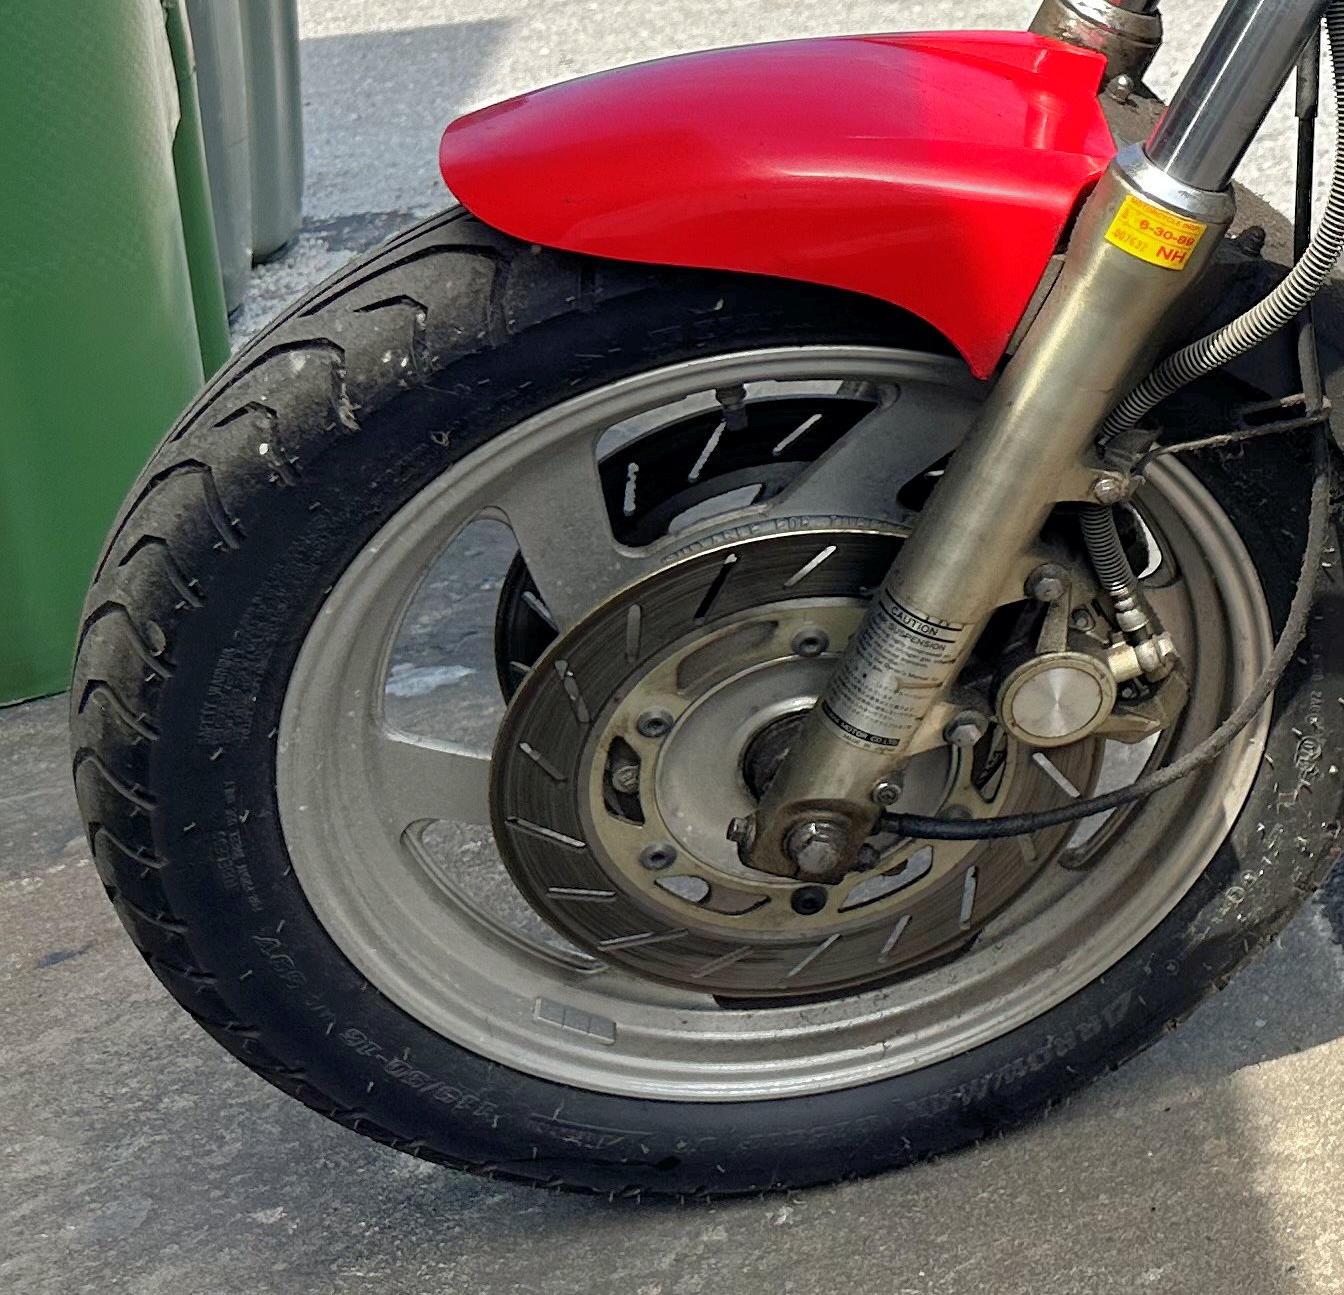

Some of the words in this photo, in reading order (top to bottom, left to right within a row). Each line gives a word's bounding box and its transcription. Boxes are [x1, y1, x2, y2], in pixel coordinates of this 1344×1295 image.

[1139, 219, 1196, 247] 6-30-89
[1156, 245, 1188, 263] NH
[890, 605, 940, 637] CAUTION
[887, 622, 947, 651] SUSPENSION
[841, 721, 869, 740] MOTOR
